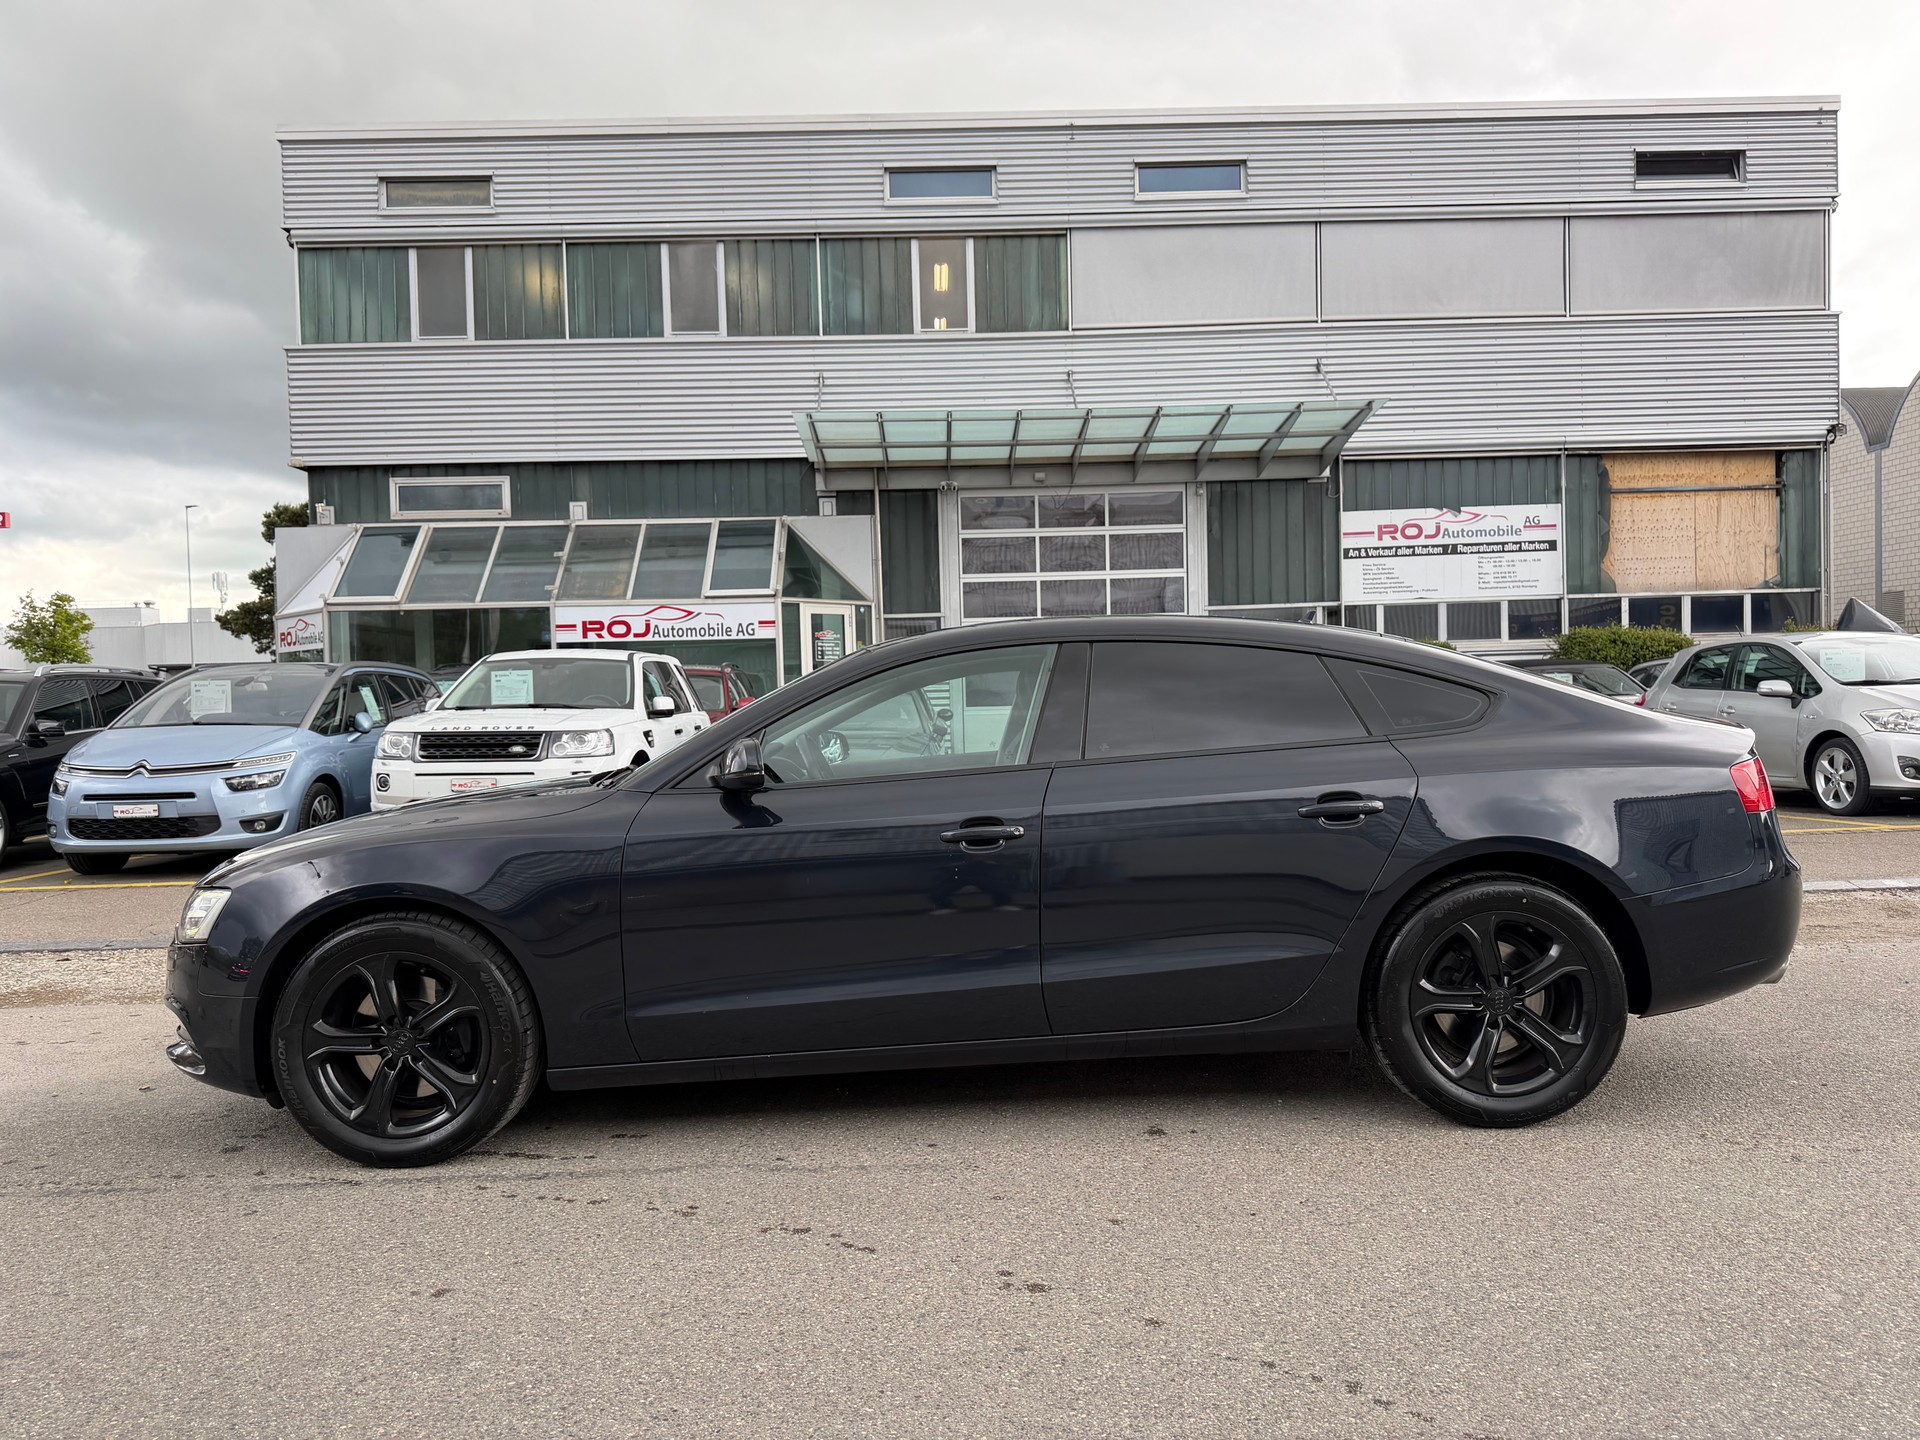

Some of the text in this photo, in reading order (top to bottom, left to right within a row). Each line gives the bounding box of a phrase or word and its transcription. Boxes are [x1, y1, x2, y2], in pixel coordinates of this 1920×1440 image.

[1377, 515, 1541, 541] ROJ Automobile AG
[1348, 548, 1359, 558] An
[1360, 548, 1366, 557] &
[1367, 547, 1395, 557] Verkauf
[1396, 546, 1413, 556] aller
[1414, 545, 1442, 555] Marken
[1457, 543, 1503, 554] Reparaturen
[1503, 543, 1520, 552] aller
[1521, 542, 1549, 551] Marken
[581, 619, 755, 639] ROJ Automobile AG
[280, 630, 297, 648] ROJ
